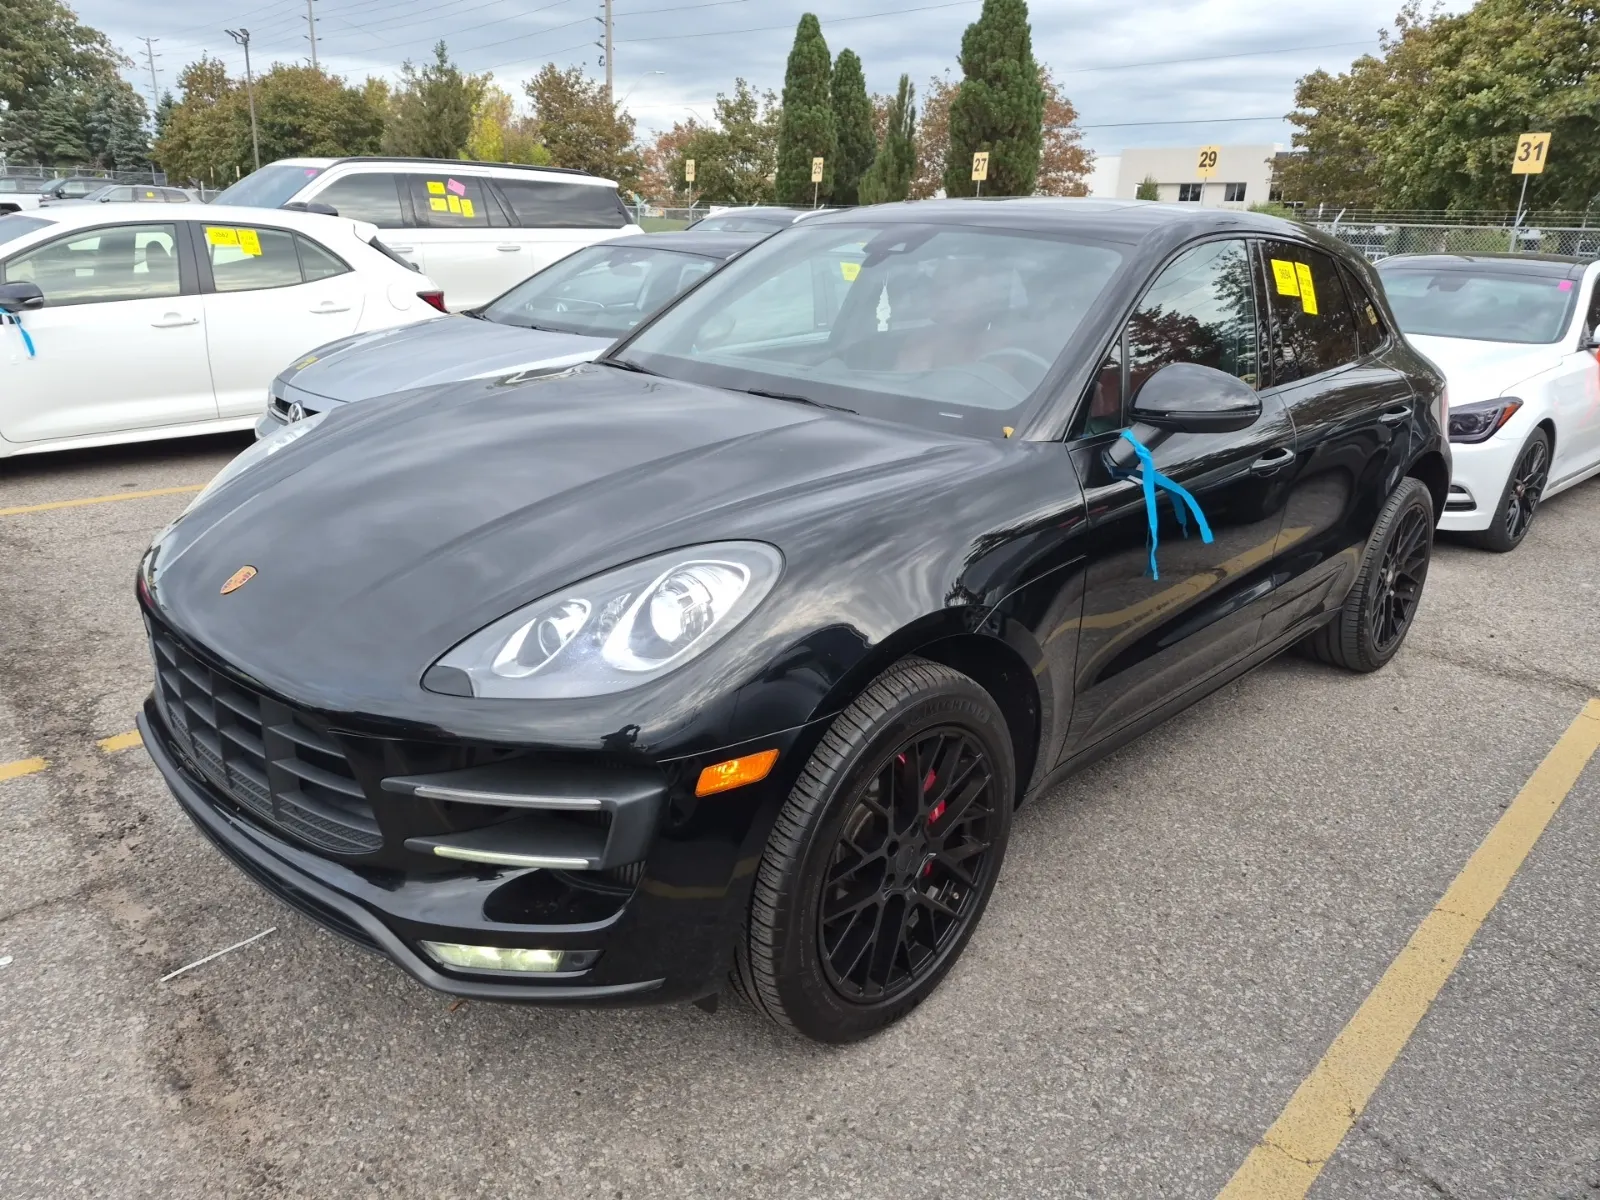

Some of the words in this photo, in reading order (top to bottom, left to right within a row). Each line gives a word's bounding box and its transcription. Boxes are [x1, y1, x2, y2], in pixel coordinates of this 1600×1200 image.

[1198, 151, 1217, 168] 29
[1518, 141, 1544, 162] 31
[813, 162, 823, 175] 25
[974, 157, 988, 172] 27
